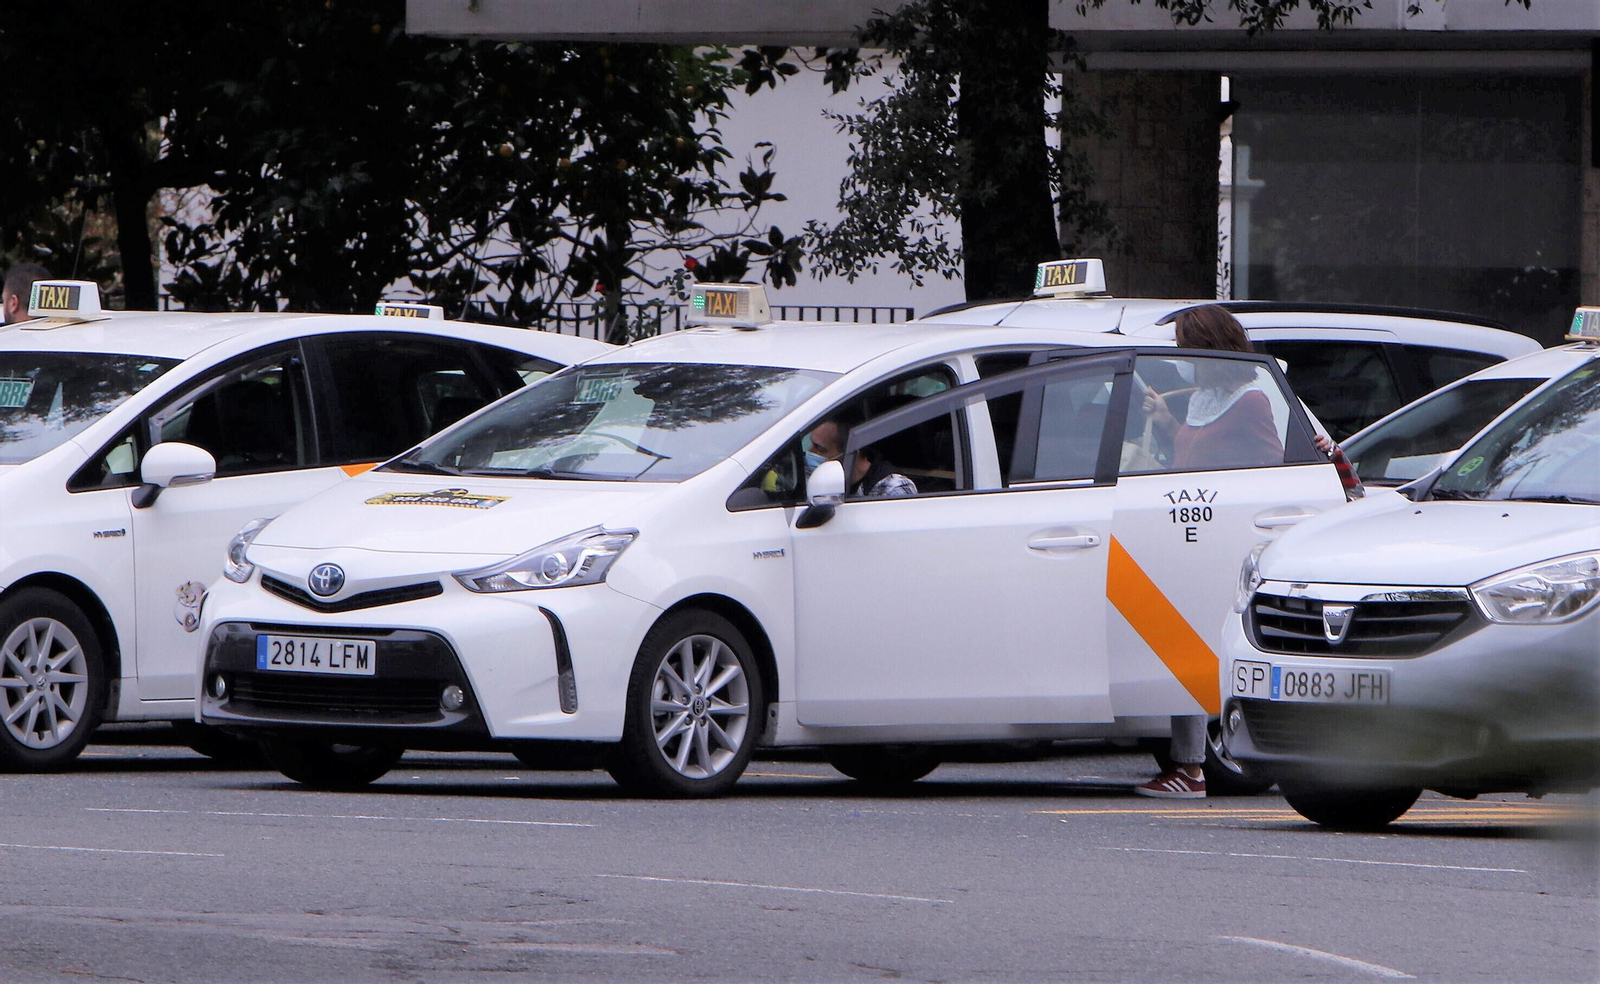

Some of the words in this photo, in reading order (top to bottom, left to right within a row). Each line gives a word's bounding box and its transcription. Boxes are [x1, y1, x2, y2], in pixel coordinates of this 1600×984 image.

[1046, 264, 1077, 286] TAXI
[40, 286, 70, 308] TAXI
[706, 291, 736, 315] TAXI
[0, 382, 31, 406] BRE
[1163, 488, 1218, 504] TAXI
[1169, 506, 1213, 523] 1880
[1185, 527, 1198, 542] E
[271, 640, 321, 667] 2814
[329, 643, 369, 669] LFM
[1236, 666, 1265, 694] SP
[1284, 671, 1335, 698] 0883
[1343, 673, 1383, 700] JFH
